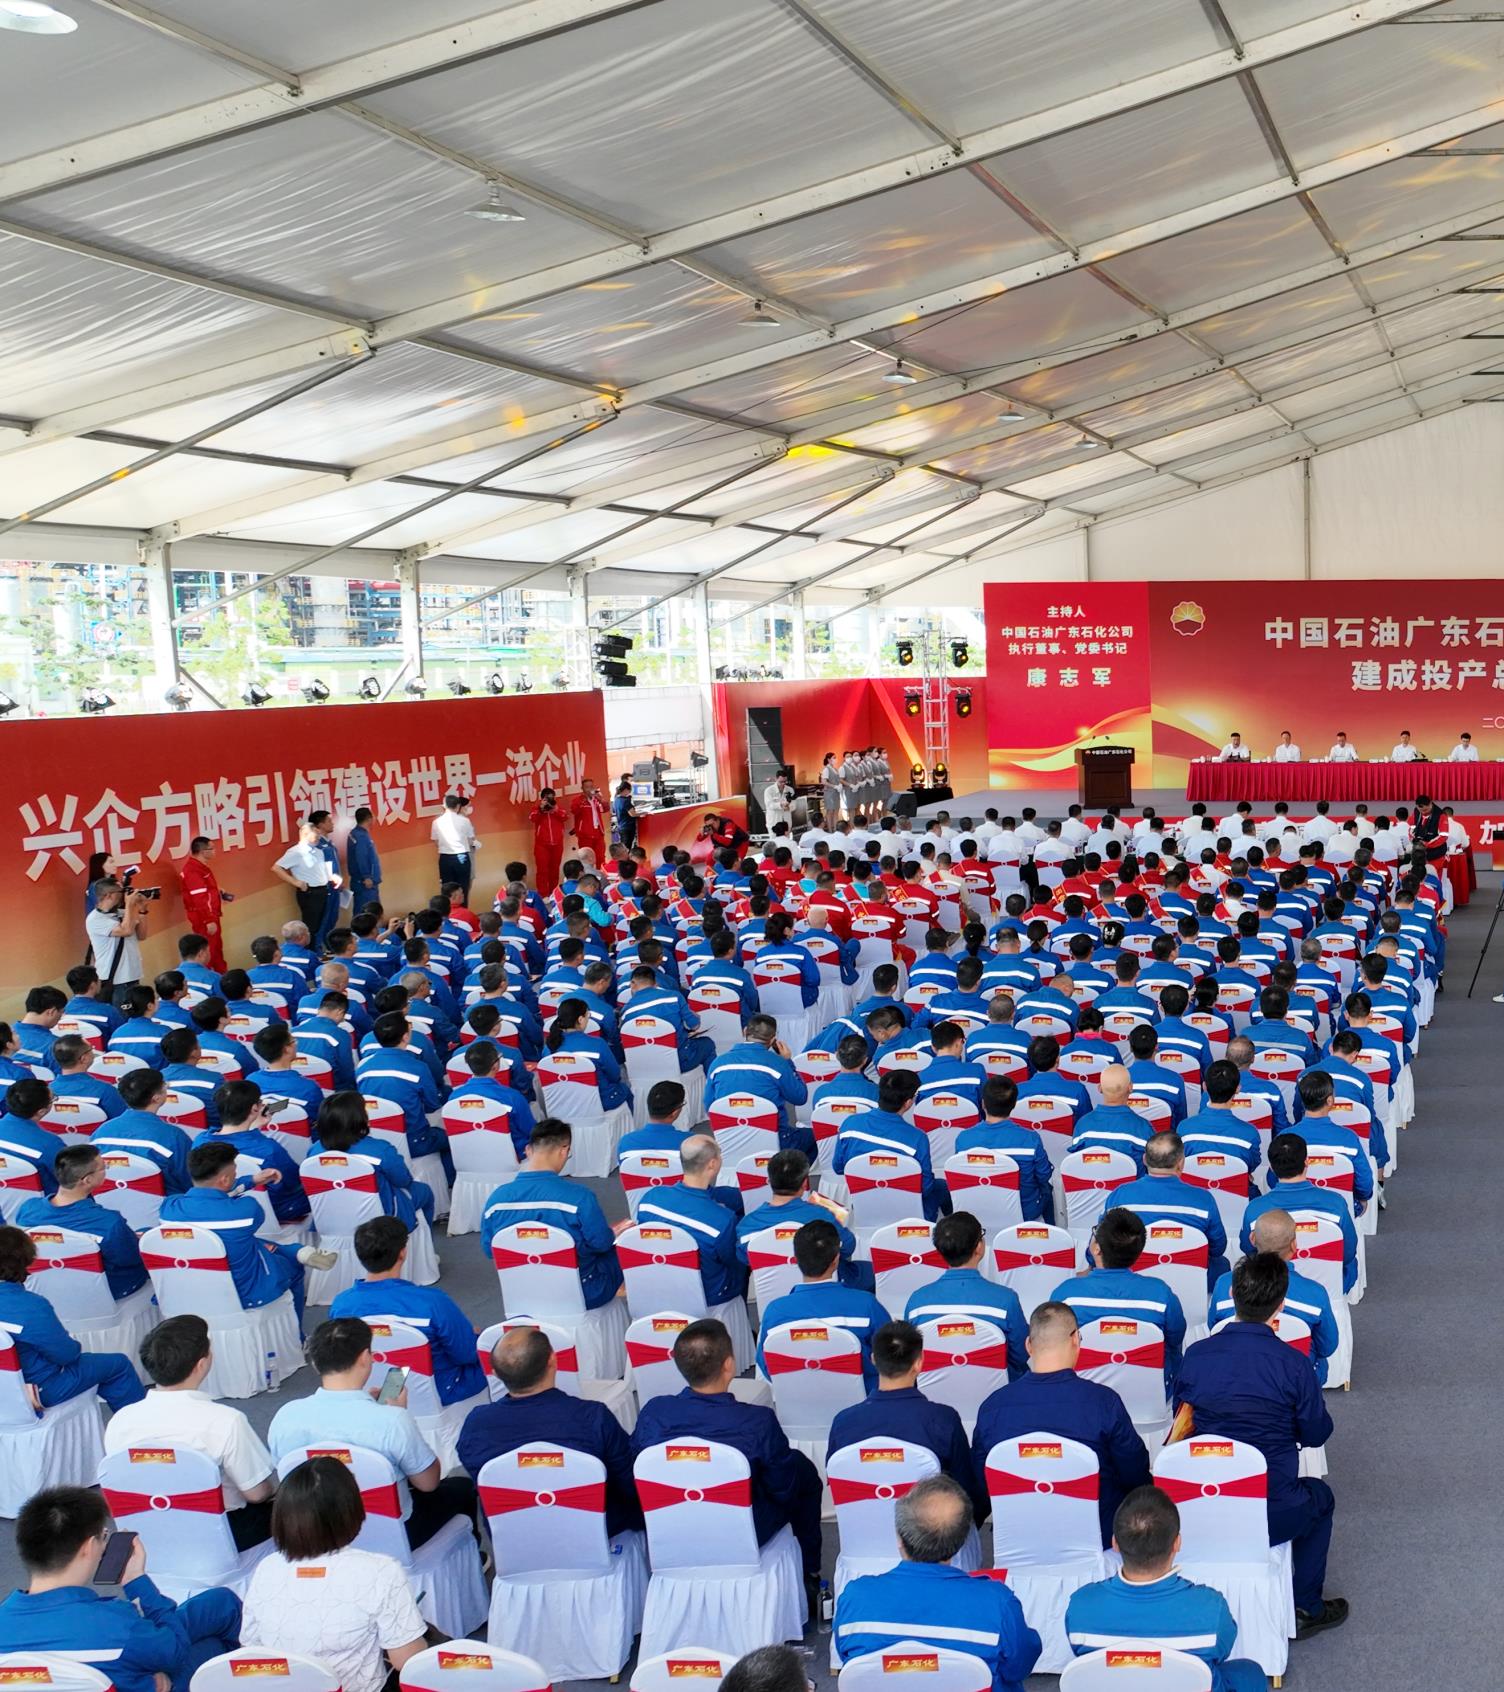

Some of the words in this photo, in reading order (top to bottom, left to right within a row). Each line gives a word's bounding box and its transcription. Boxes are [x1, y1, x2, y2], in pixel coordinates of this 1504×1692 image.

[1047, 605, 1086, 618] 主持人
[1001, 625, 1134, 639] 中国石油广东石化公司
[1008, 642, 1128, 656] 执行董事、党委书记
[1026, 667, 1112, 688] 康志军
[19, 740, 587, 882] 兴企方略引领建设世界一流企业
